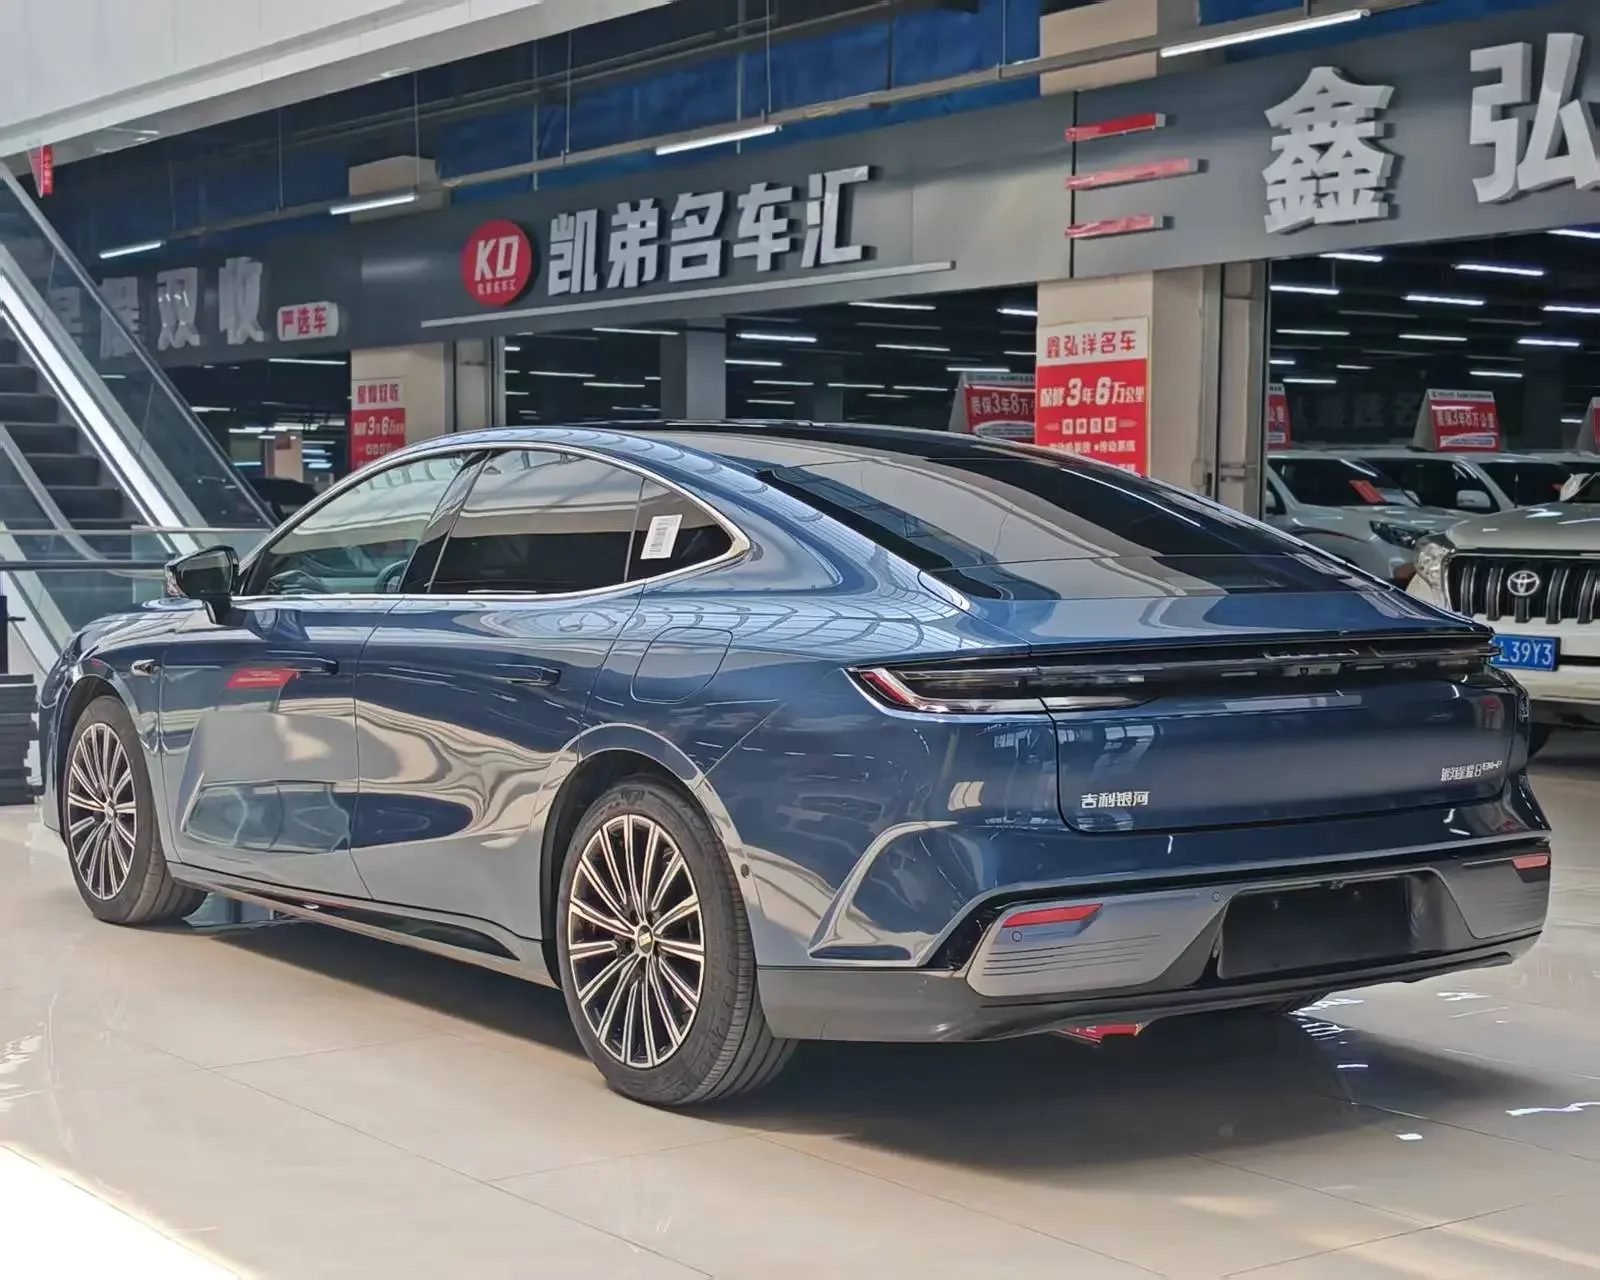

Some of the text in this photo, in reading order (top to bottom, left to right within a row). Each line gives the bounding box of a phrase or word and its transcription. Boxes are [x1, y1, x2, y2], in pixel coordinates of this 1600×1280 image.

[1262, 33, 1600, 233] 鑫弘
[548, 165, 869, 296] 凯弟名车汇
[474, 235, 519, 281] KD
[281, 307, 327, 336] 严选车
[1046, 330, 1136, 358] 鑫弘洋名车
[1081, 791, 1150, 809] 吉利银河
